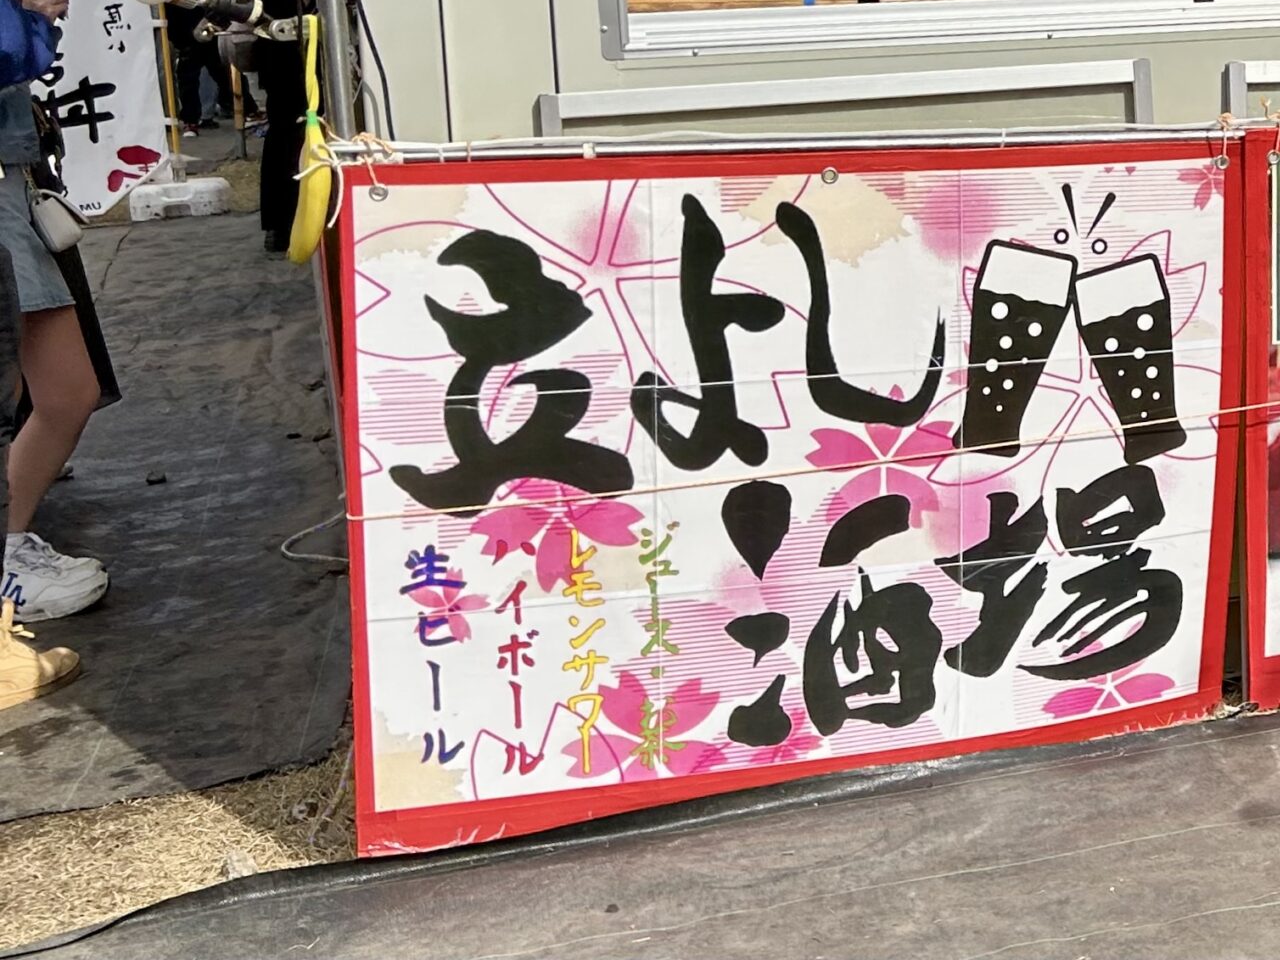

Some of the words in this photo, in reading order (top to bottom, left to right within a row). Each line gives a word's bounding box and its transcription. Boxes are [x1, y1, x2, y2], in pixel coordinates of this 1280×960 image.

[399, 543, 467, 765] 生ビール
[492, 539, 544, 776] ハイボール
[562, 527, 610, 775] レモンサワー
[631, 520, 687, 770] ジュース・お茶
[721, 463, 1185, 748] 酒場
